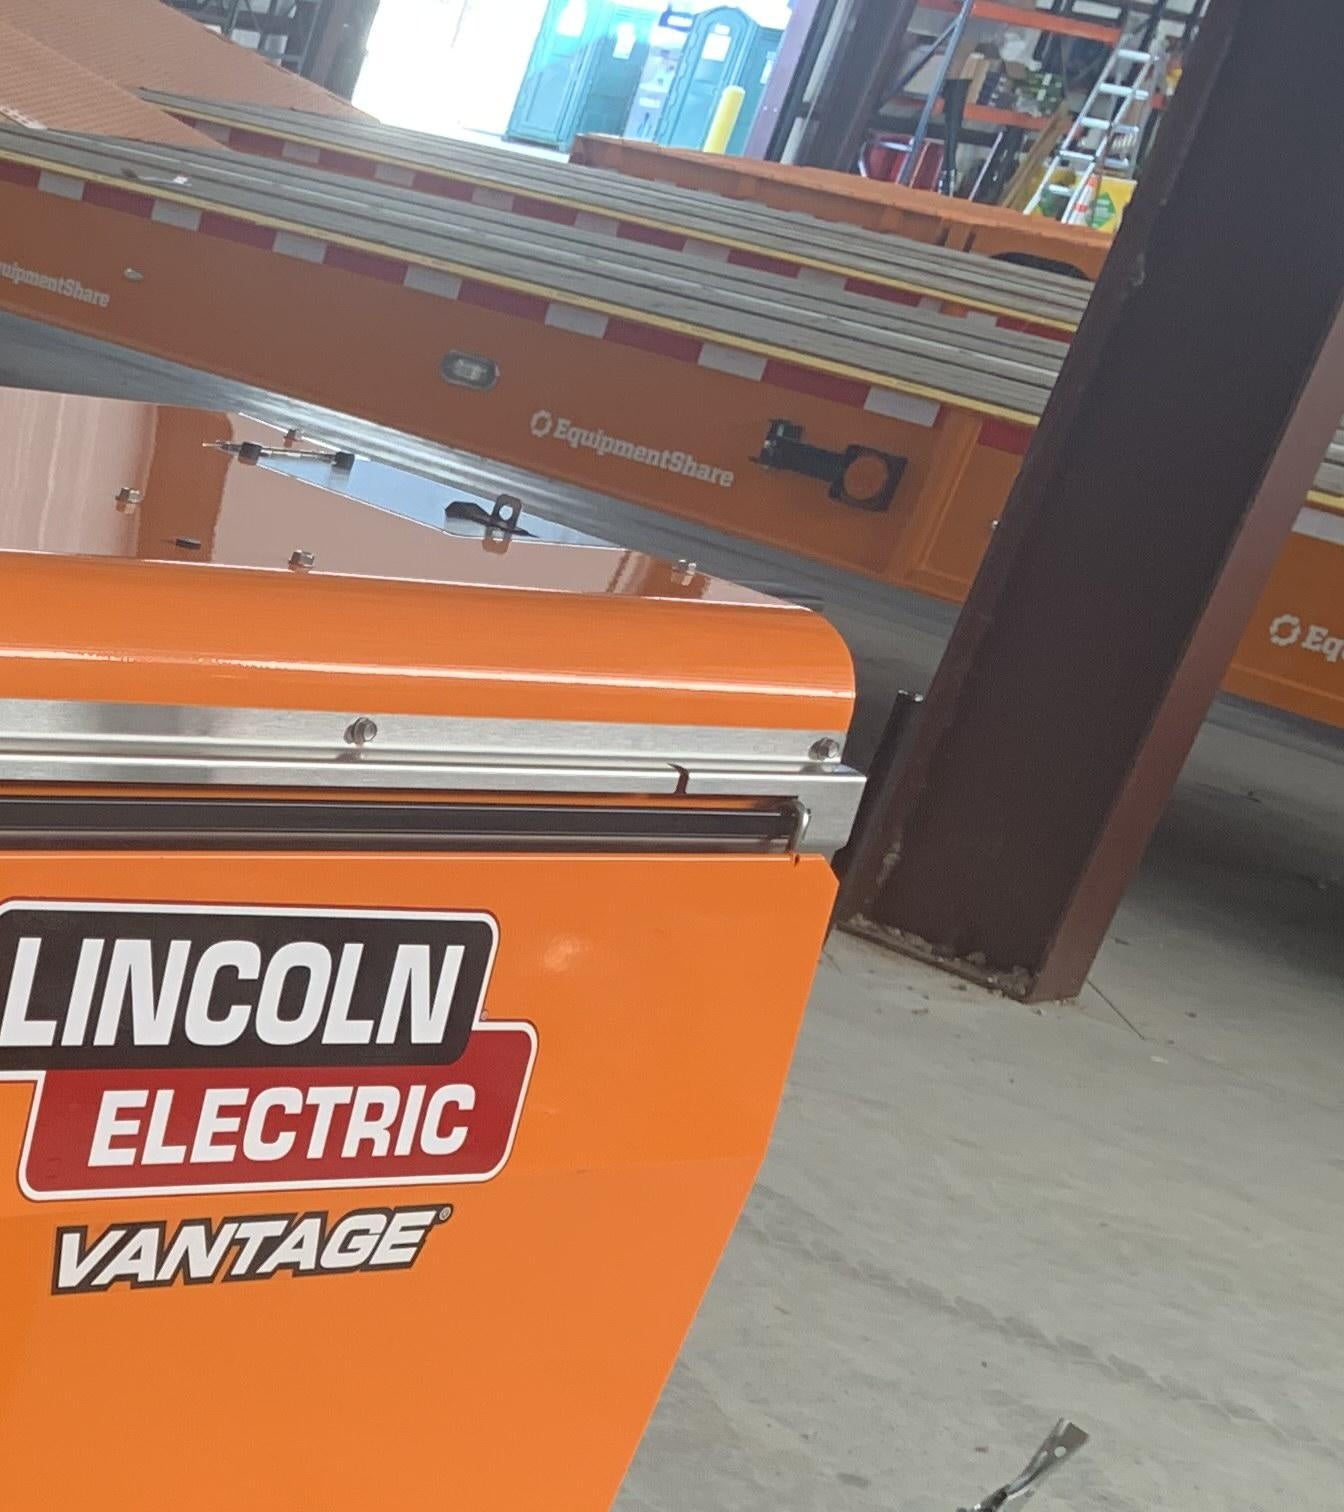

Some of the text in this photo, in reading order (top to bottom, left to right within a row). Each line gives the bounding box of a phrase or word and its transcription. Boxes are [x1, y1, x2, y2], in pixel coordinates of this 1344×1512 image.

[553, 418, 735, 487] EquipmentShare
[1301, 624, 1344, 662] Eq
[88, 1084, 476, 1168] ELECTRIC
